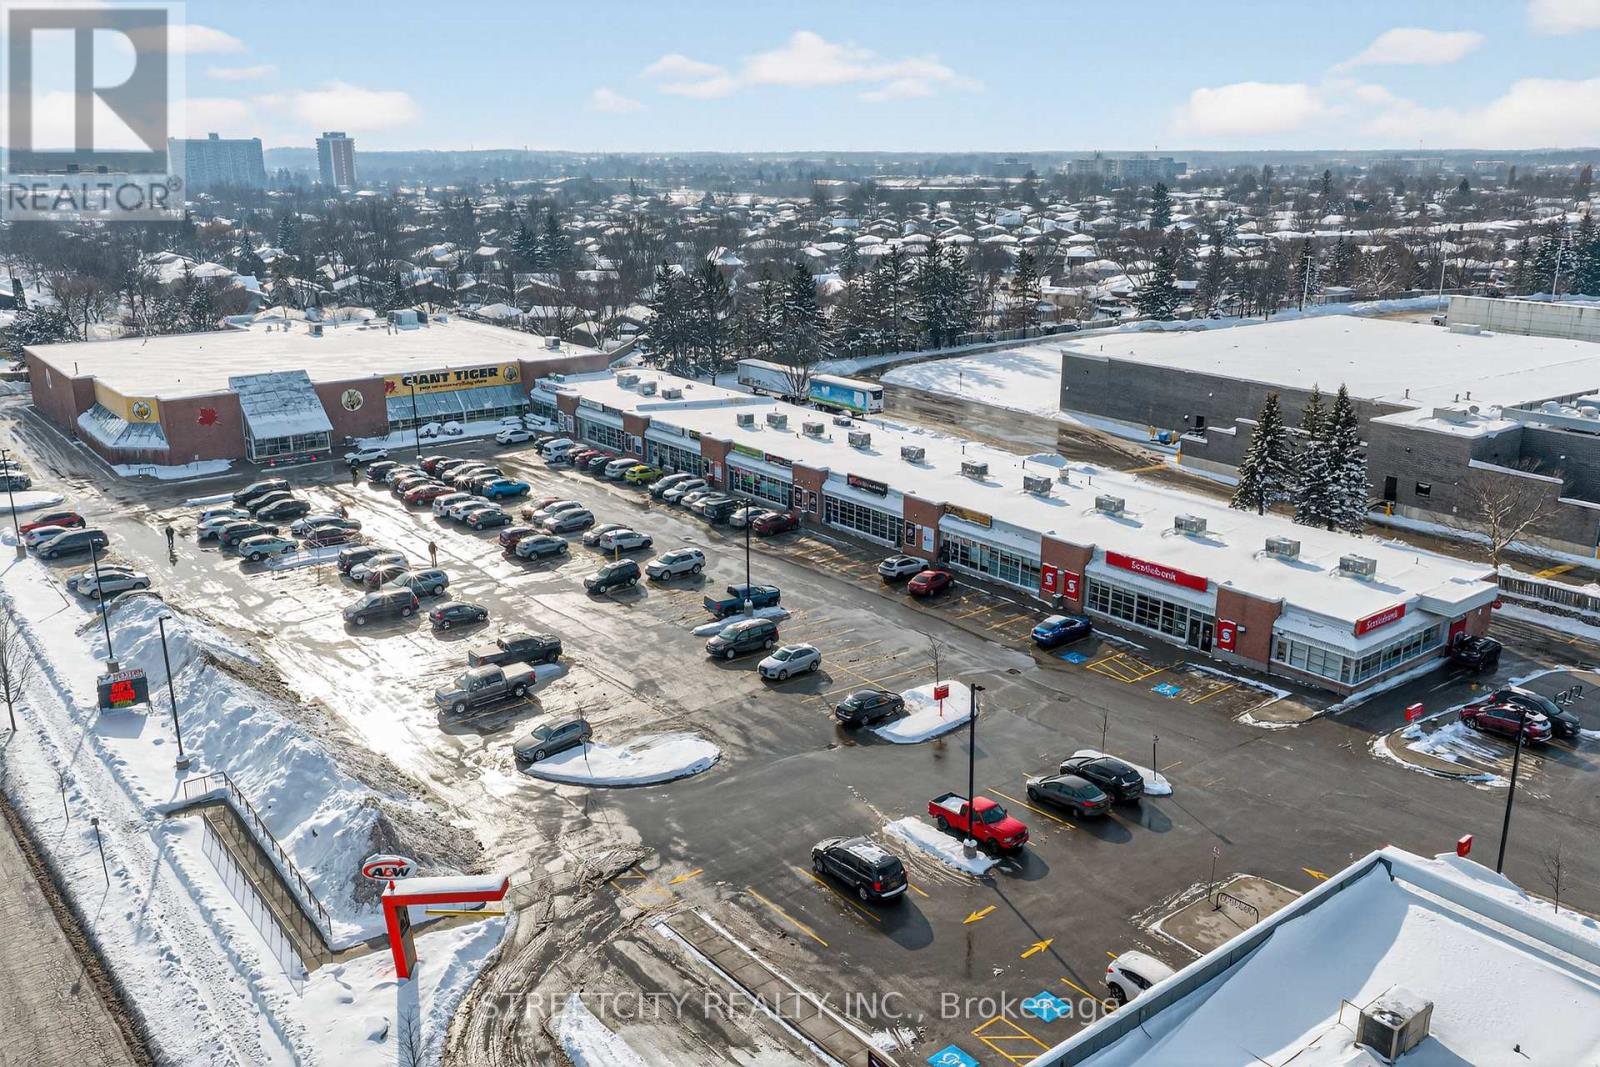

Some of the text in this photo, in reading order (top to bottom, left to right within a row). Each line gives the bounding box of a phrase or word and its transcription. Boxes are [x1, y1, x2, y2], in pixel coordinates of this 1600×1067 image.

[402, 373, 450, 386] GIANT
[454, 367, 498, 381] TIGER
[1131, 560, 1177, 582] Scotiabank
[1365, 609, 1399, 630] Scotiabank
[371, 867, 411, 877] A&W
